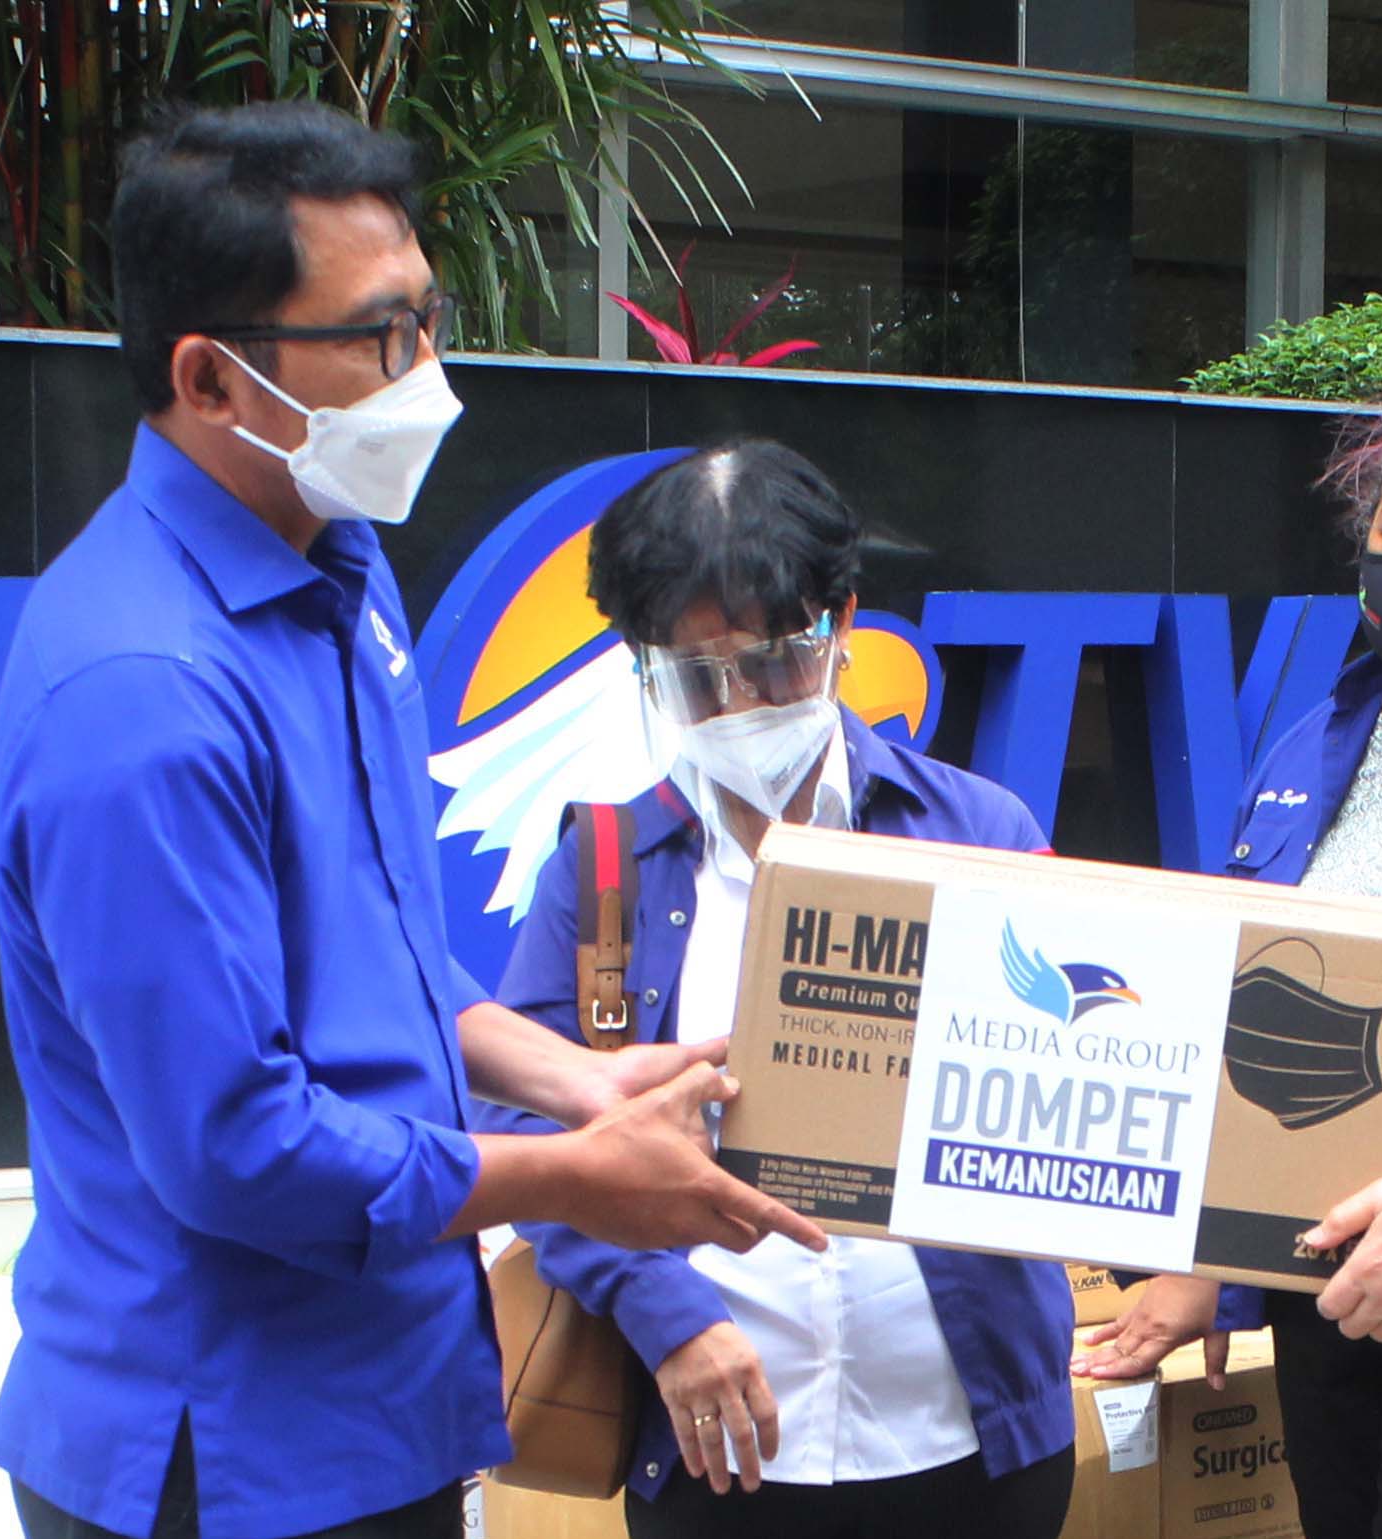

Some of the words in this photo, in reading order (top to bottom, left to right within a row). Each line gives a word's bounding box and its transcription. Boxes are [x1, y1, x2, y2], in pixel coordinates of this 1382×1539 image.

[795, 978, 886, 1006] Premium
[779, 1014, 840, 1038] THICK,
[946, 1012, 1062, 1058] MEDIA
[1076, 1033, 1200, 1074] GROUP
[772, 1041, 871, 1074] MEDICAL
[931, 1061, 1192, 1162] DOMPET
[938, 1145, 1166, 1211] KEMANUSIAAN
